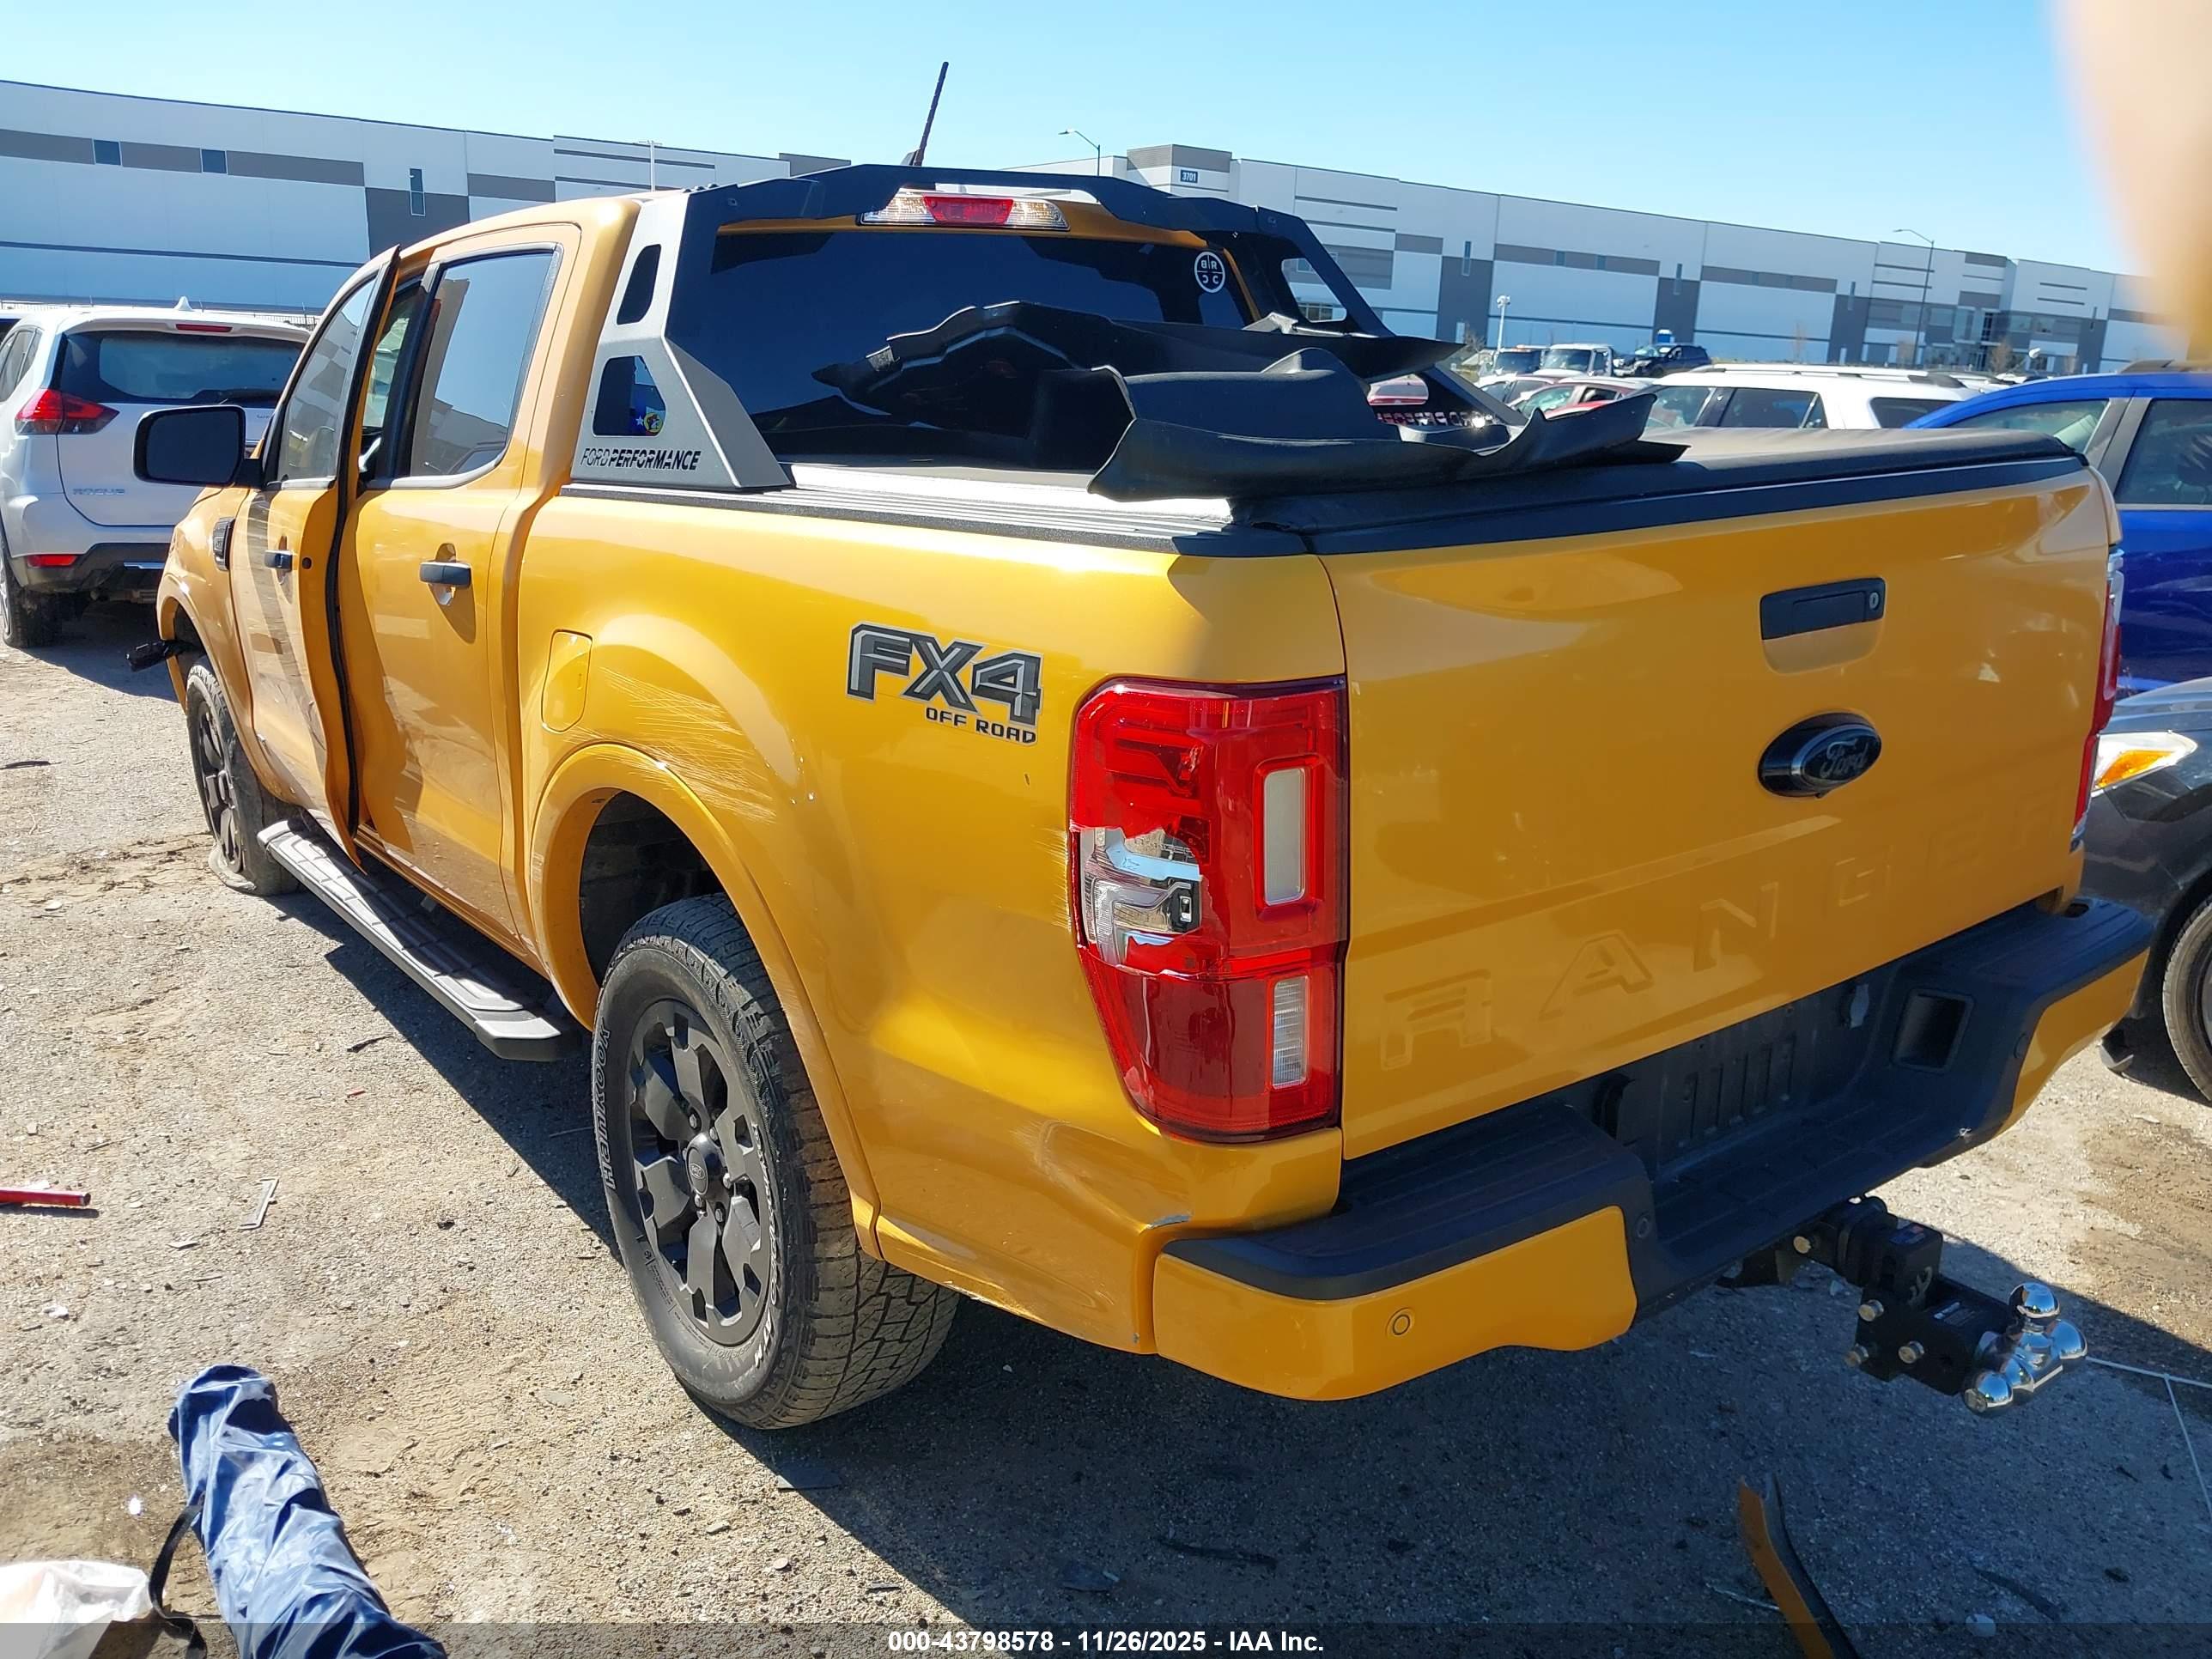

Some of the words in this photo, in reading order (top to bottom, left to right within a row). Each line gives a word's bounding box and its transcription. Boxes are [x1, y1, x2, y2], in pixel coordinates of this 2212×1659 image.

[1182, 172, 1196, 182] 3701
[580, 447, 611, 466] FORD
[609, 447, 702, 471] PERFORMANCE
[847, 622, 1042, 727] FX4
[926, 707, 967, 727] OFF
[975, 719, 1037, 744] ROAD
[1820, 738, 1869, 779] Ford
[1380, 779, 2069, 1072] RANGER
